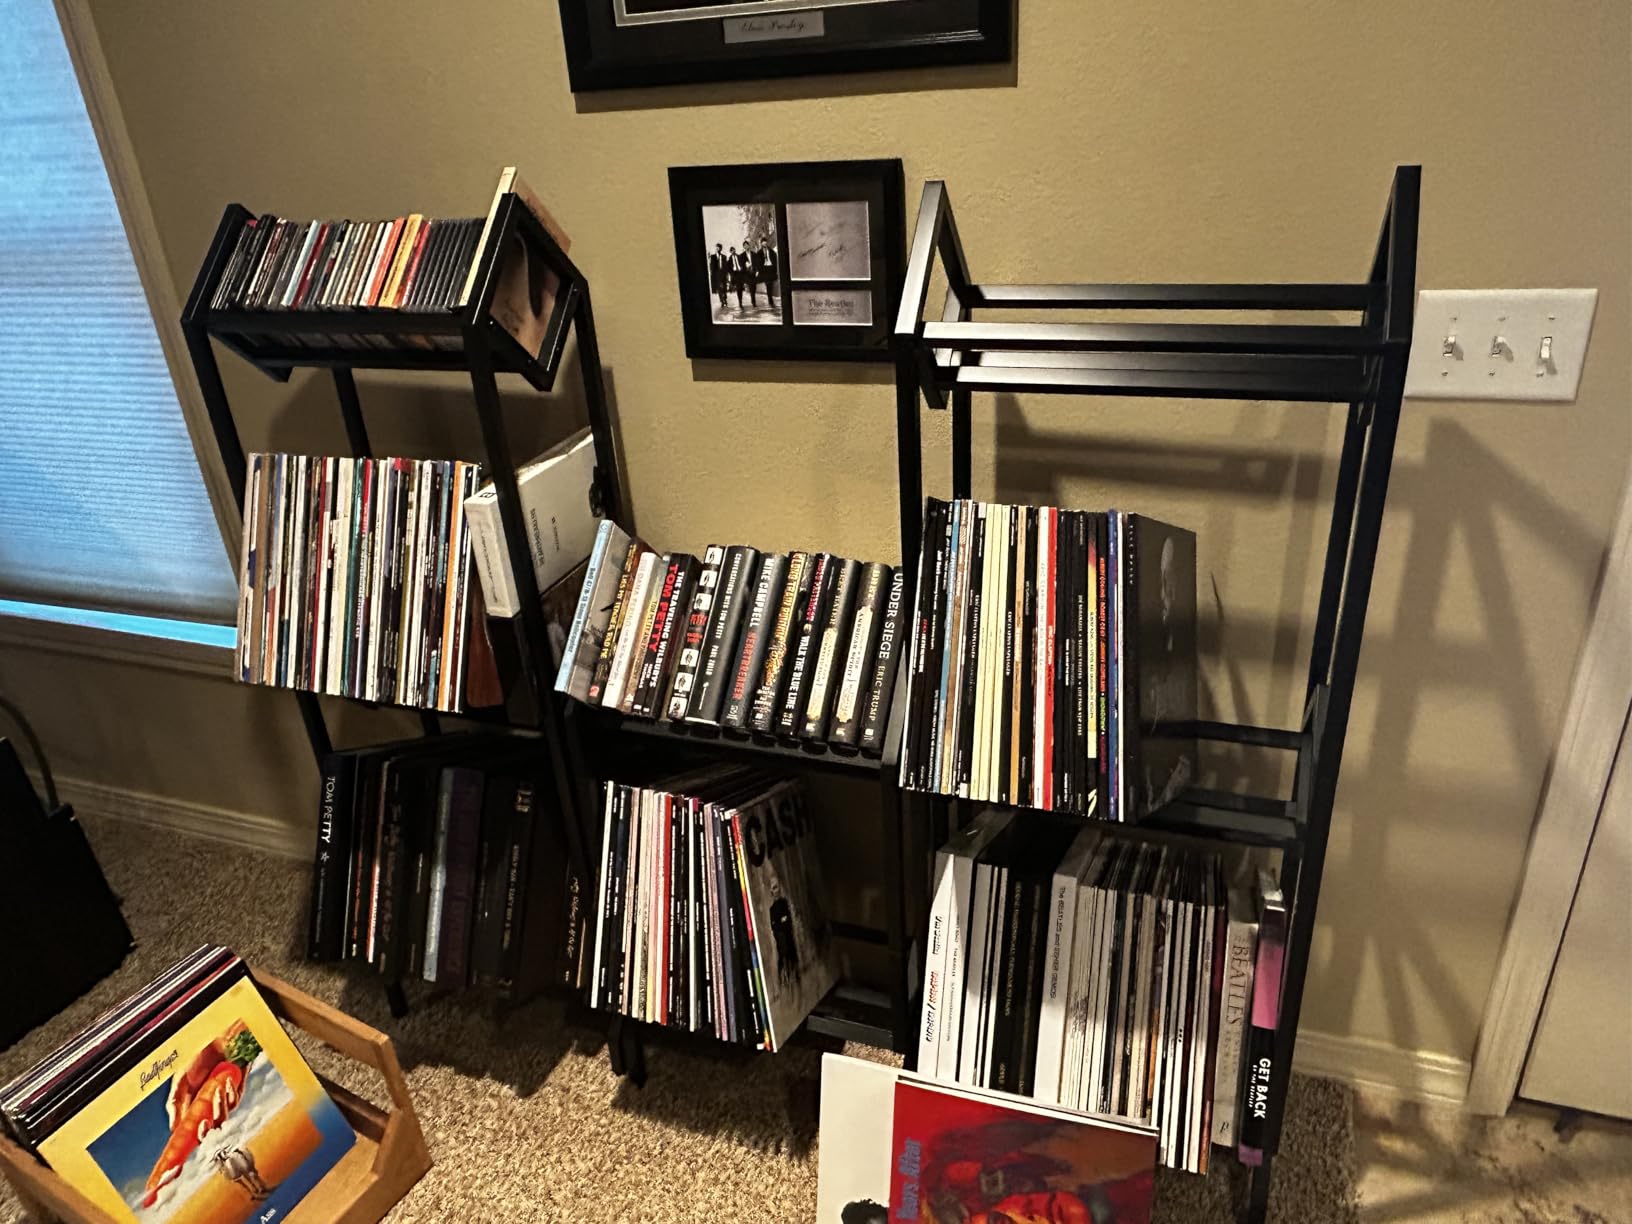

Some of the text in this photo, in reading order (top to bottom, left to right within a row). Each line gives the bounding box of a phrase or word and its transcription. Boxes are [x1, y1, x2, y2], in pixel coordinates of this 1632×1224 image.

[727, 553, 741, 594] CONVERSATIONS
[649, 563, 678, 653] TOM PETTY
[723, 596, 731, 609] WITH
[783, 581, 796, 606] TRAIN
[807, 582, 821, 622] PATTERSON
[568, 621, 582, 653] Helicopter
[650, 571, 684, 688] THE TRAVELING WILBURYS
[716, 623, 724, 639] PETTY
[733, 558, 774, 700] MIKE CAMPBELL HEARTBREAKER
[711, 645, 719, 658] PAUL
[798, 635, 810, 656] WALK
[869, 572, 904, 721] UNDER SIEGE ERIC TRUMP
[640, 663, 649, 689] THOMAS
[795, 657, 805, 672] THE
[790, 672, 802, 691] BLUE
[787, 692, 797, 710] LINE
[321, 775, 335, 843] TOM PETTY
[1056, 900, 1065, 932] BEATLES
[1226, 945, 1248, 1026] BEATLES
[1254, 1058, 1271, 1118] GET BACK
